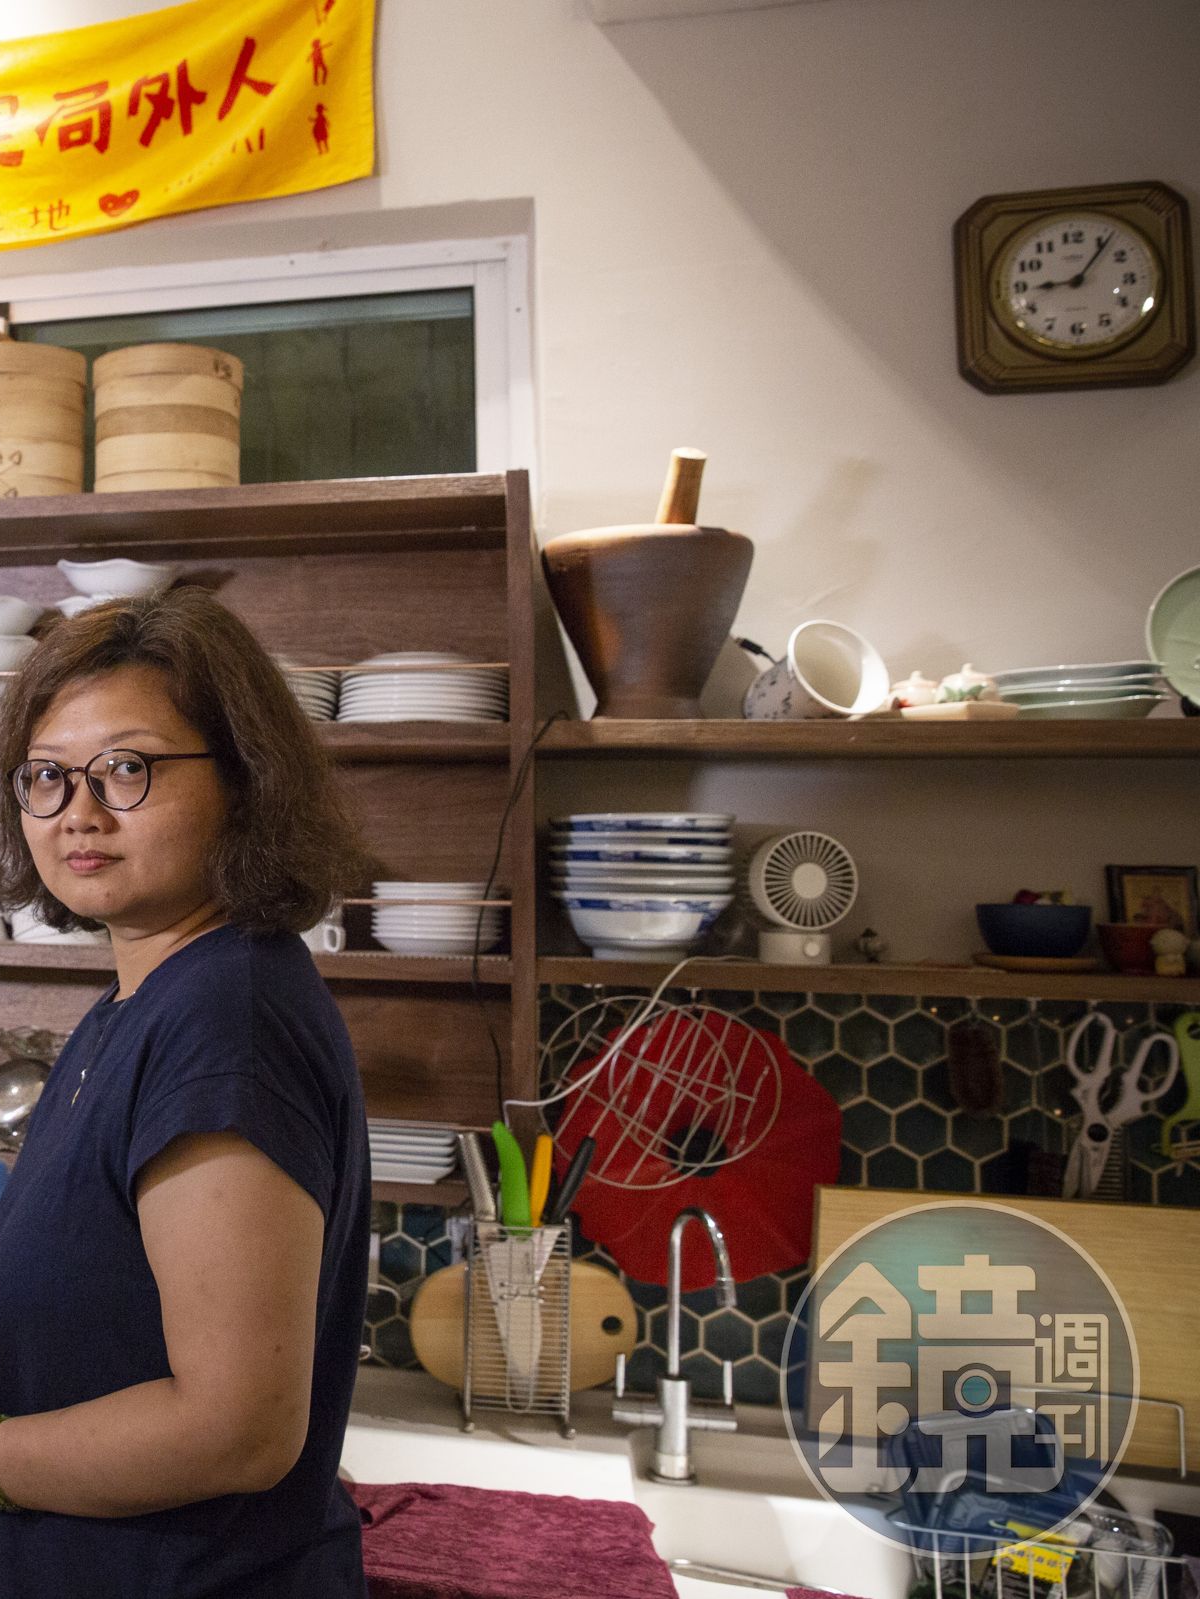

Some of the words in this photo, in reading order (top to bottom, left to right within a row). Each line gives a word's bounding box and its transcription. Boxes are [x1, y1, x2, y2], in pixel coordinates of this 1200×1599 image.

[1062, 230, 1085, 244] 12
[1035, 241, 1054, 254] 11
[1114, 250, 1127, 263] 2
[1018, 259, 1042, 273] 10
[1122, 272, 1137, 286] 3
[1014, 281, 1028, 294] 9
[1098, 313, 1113, 328] 5
[1070, 322, 1086, 336] 6
